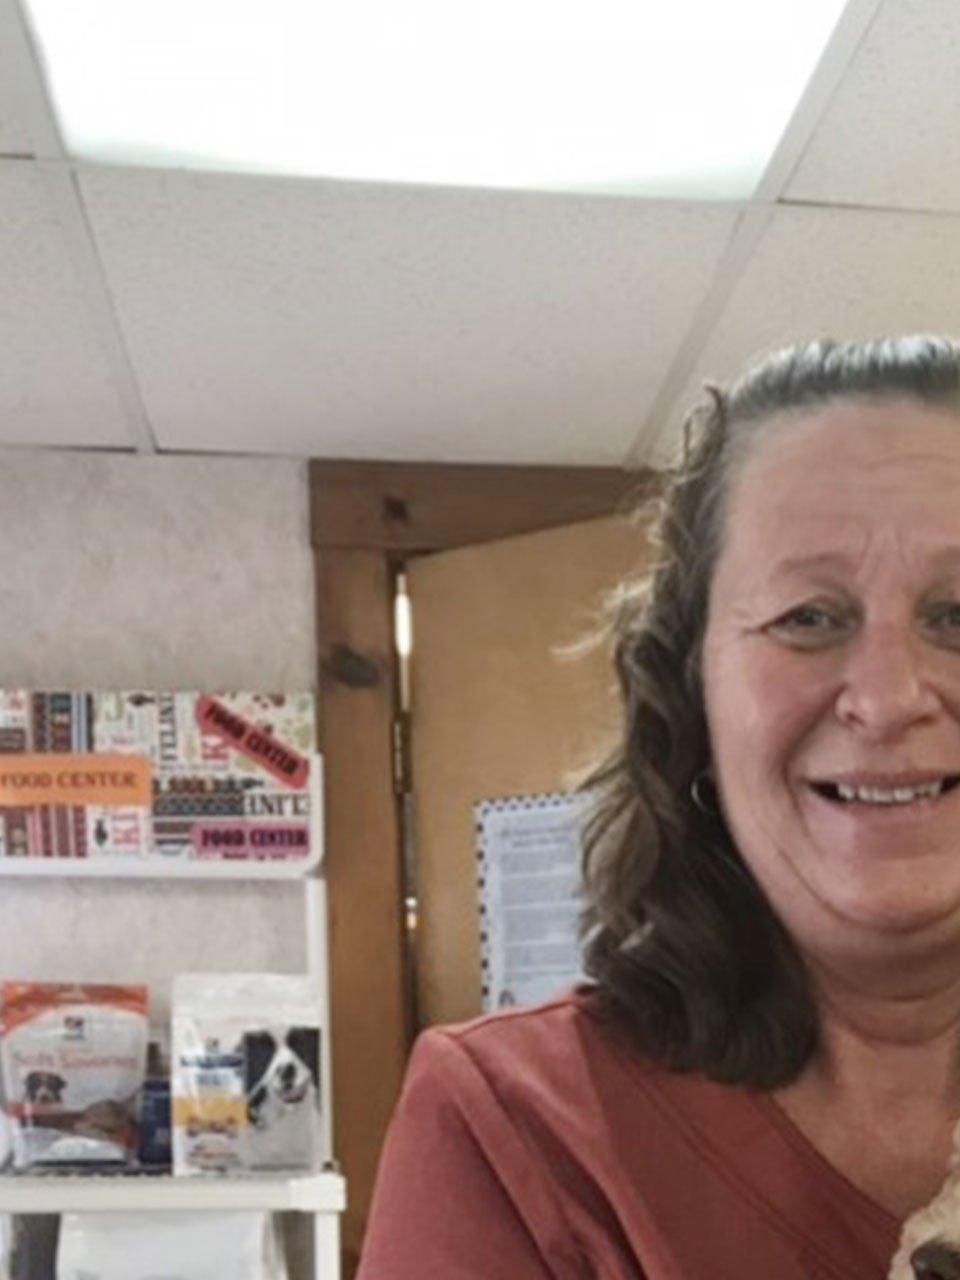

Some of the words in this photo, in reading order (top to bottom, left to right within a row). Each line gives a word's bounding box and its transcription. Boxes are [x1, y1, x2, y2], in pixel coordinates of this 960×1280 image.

[204, 702, 246, 740] FOOD
[246, 731, 299, 776] CENTER
[56, 771, 136, 789] CENTER
[201, 828, 246, 847] FOOD
[250, 828, 308, 847] CENTER
